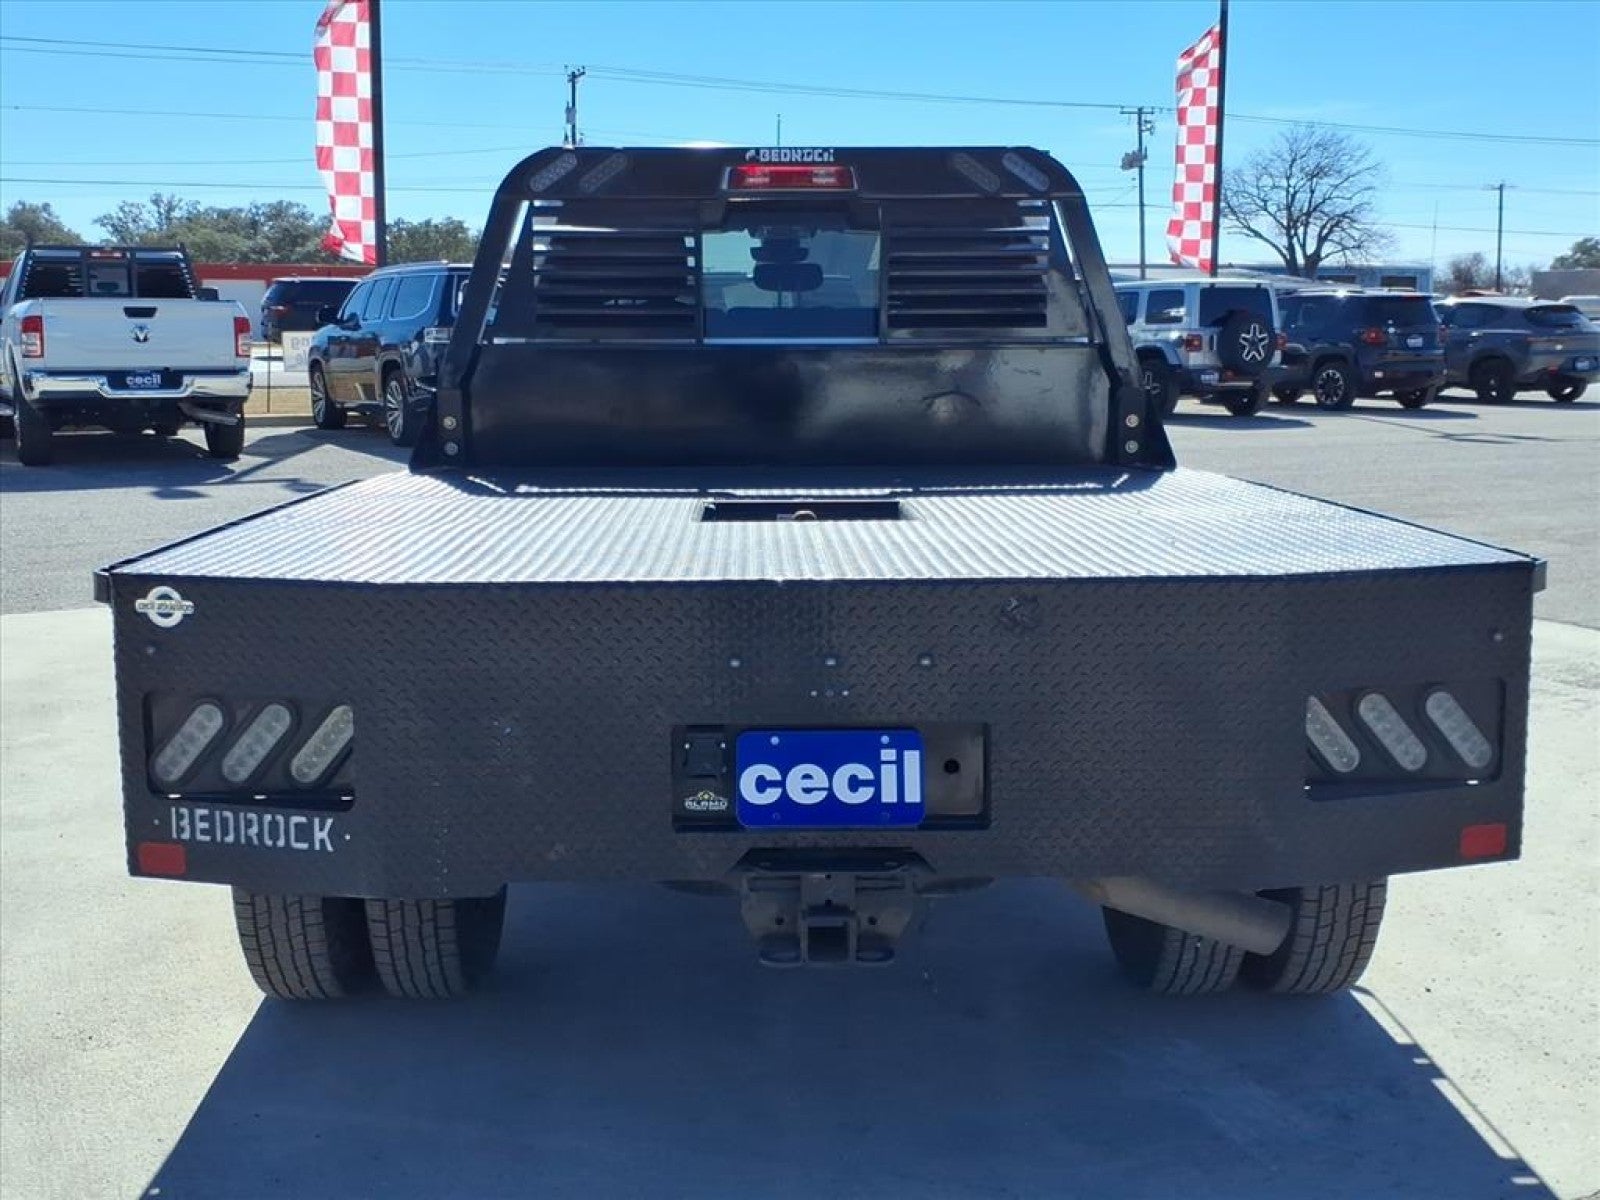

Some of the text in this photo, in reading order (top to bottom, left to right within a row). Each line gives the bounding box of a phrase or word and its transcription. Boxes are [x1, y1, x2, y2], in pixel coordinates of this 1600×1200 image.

[126, 374, 161, 385] cecil
[739, 749, 921, 805] cecil
[684, 800, 728, 808] ALAMO
[170, 806, 334, 852] BEDROCK
